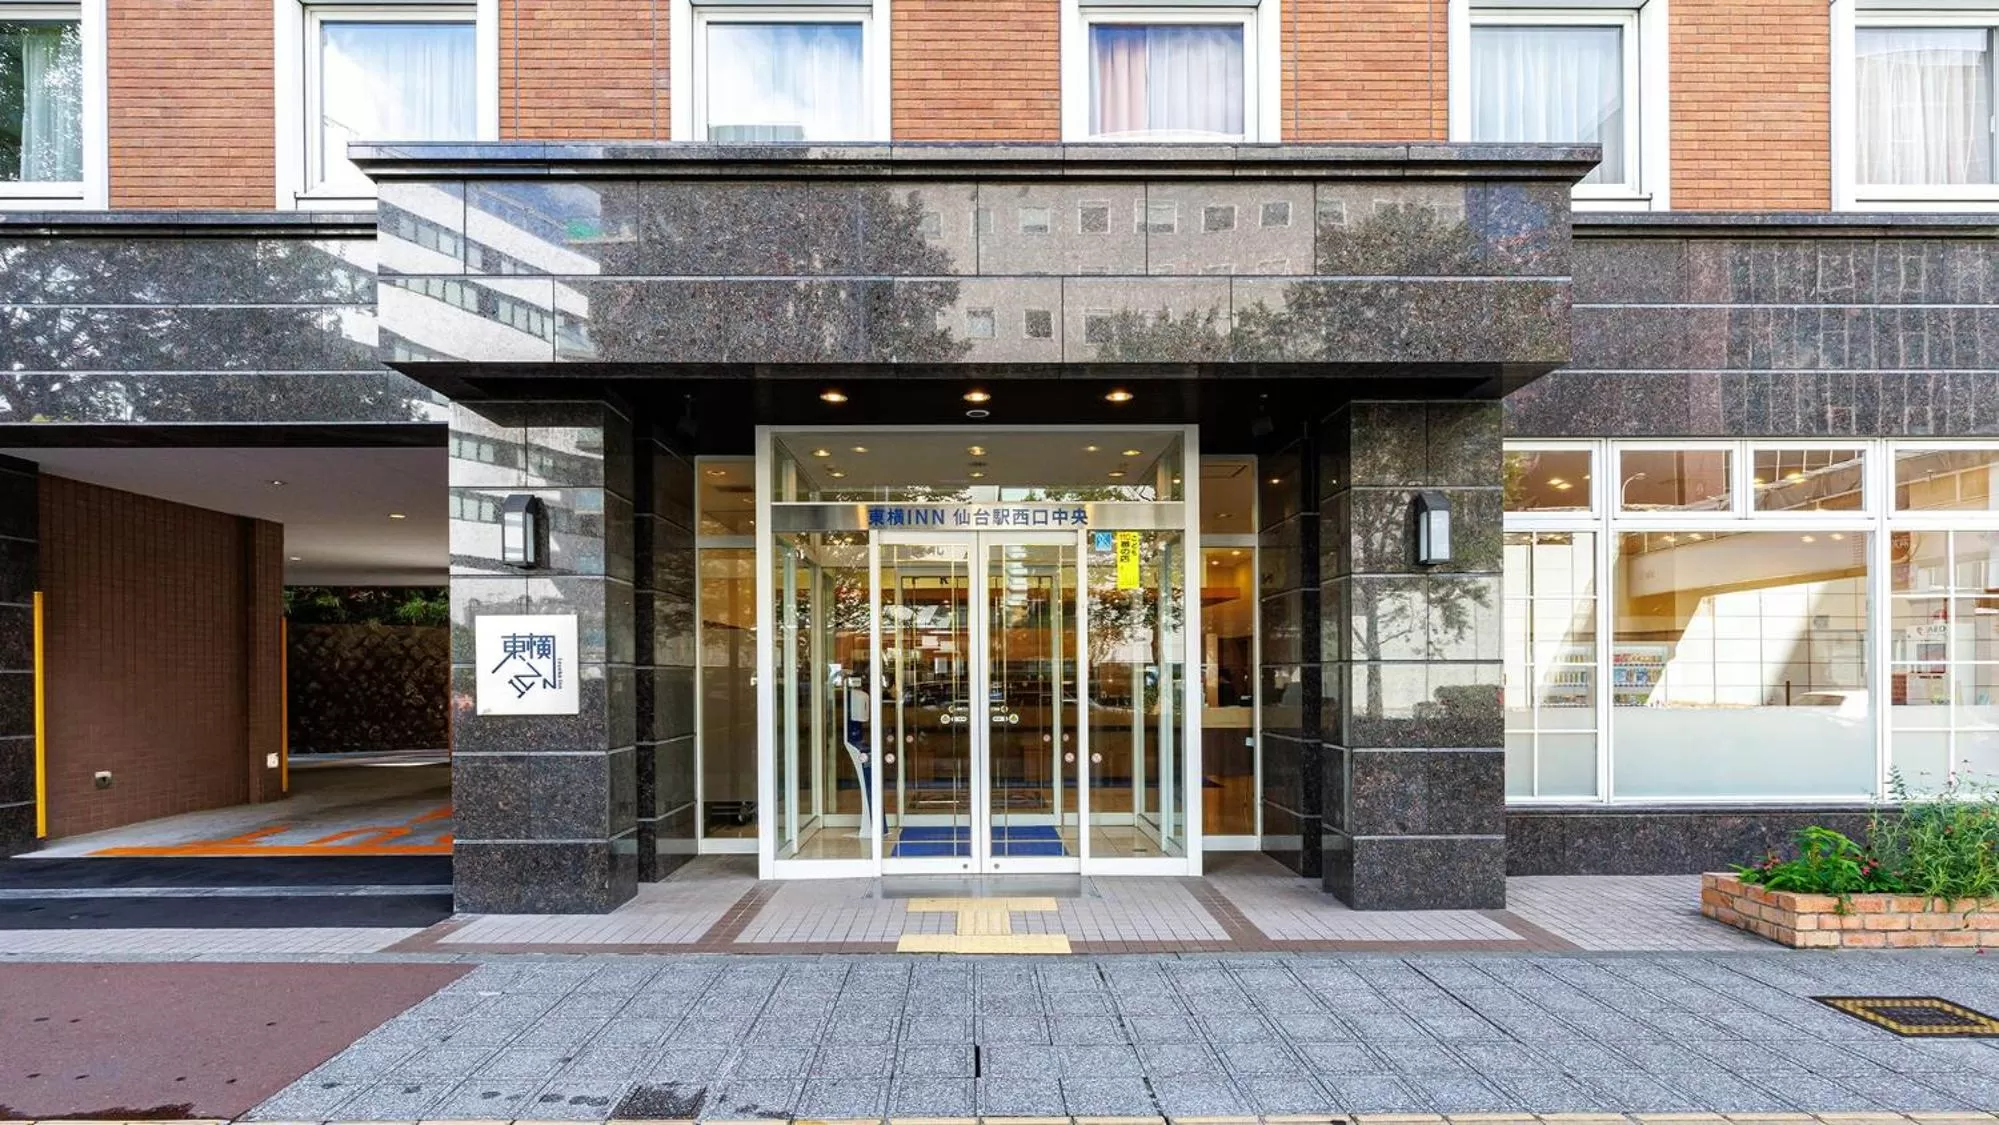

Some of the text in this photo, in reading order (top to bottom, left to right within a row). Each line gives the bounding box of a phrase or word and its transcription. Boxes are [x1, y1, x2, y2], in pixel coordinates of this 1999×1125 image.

[868, 508, 1088, 526] 東横INN 仙台駅西口中央
